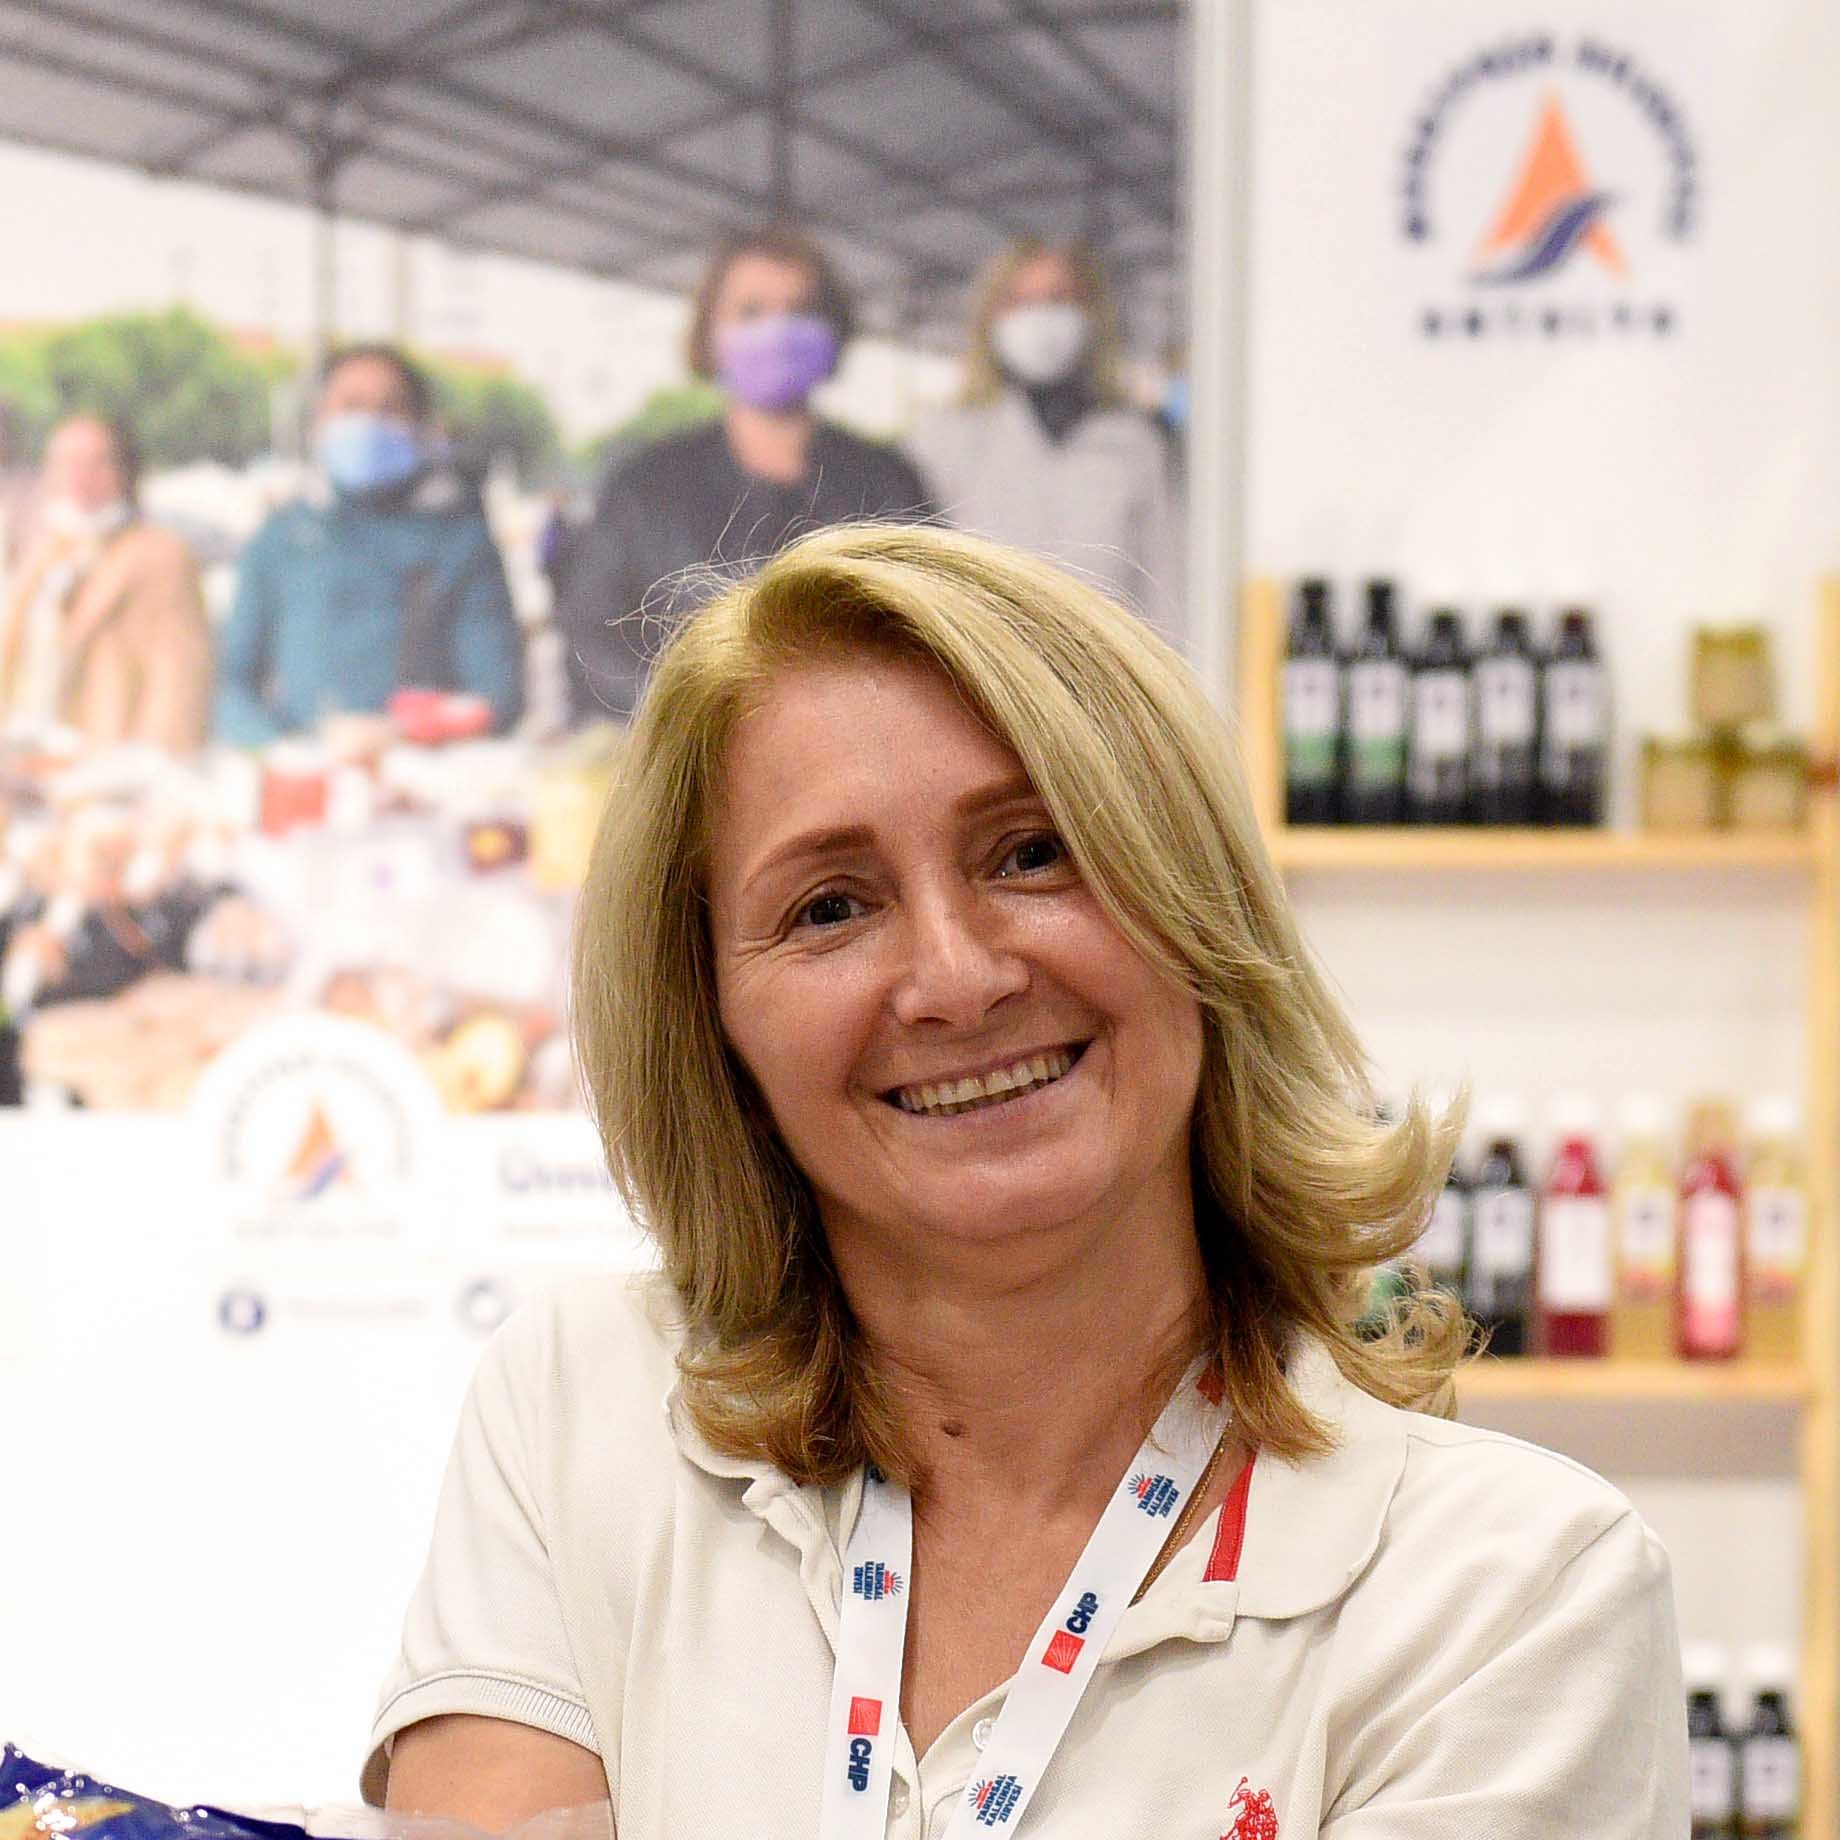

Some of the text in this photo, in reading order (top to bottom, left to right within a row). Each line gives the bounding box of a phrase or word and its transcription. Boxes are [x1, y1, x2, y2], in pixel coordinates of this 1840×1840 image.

[1066, 1592, 1098, 1634] CHP
[847, 1738, 872, 1792] CHP
[976, 1774, 1007, 1821] TARIMSAL
[985, 1776, 1017, 1826] KALKINMA
